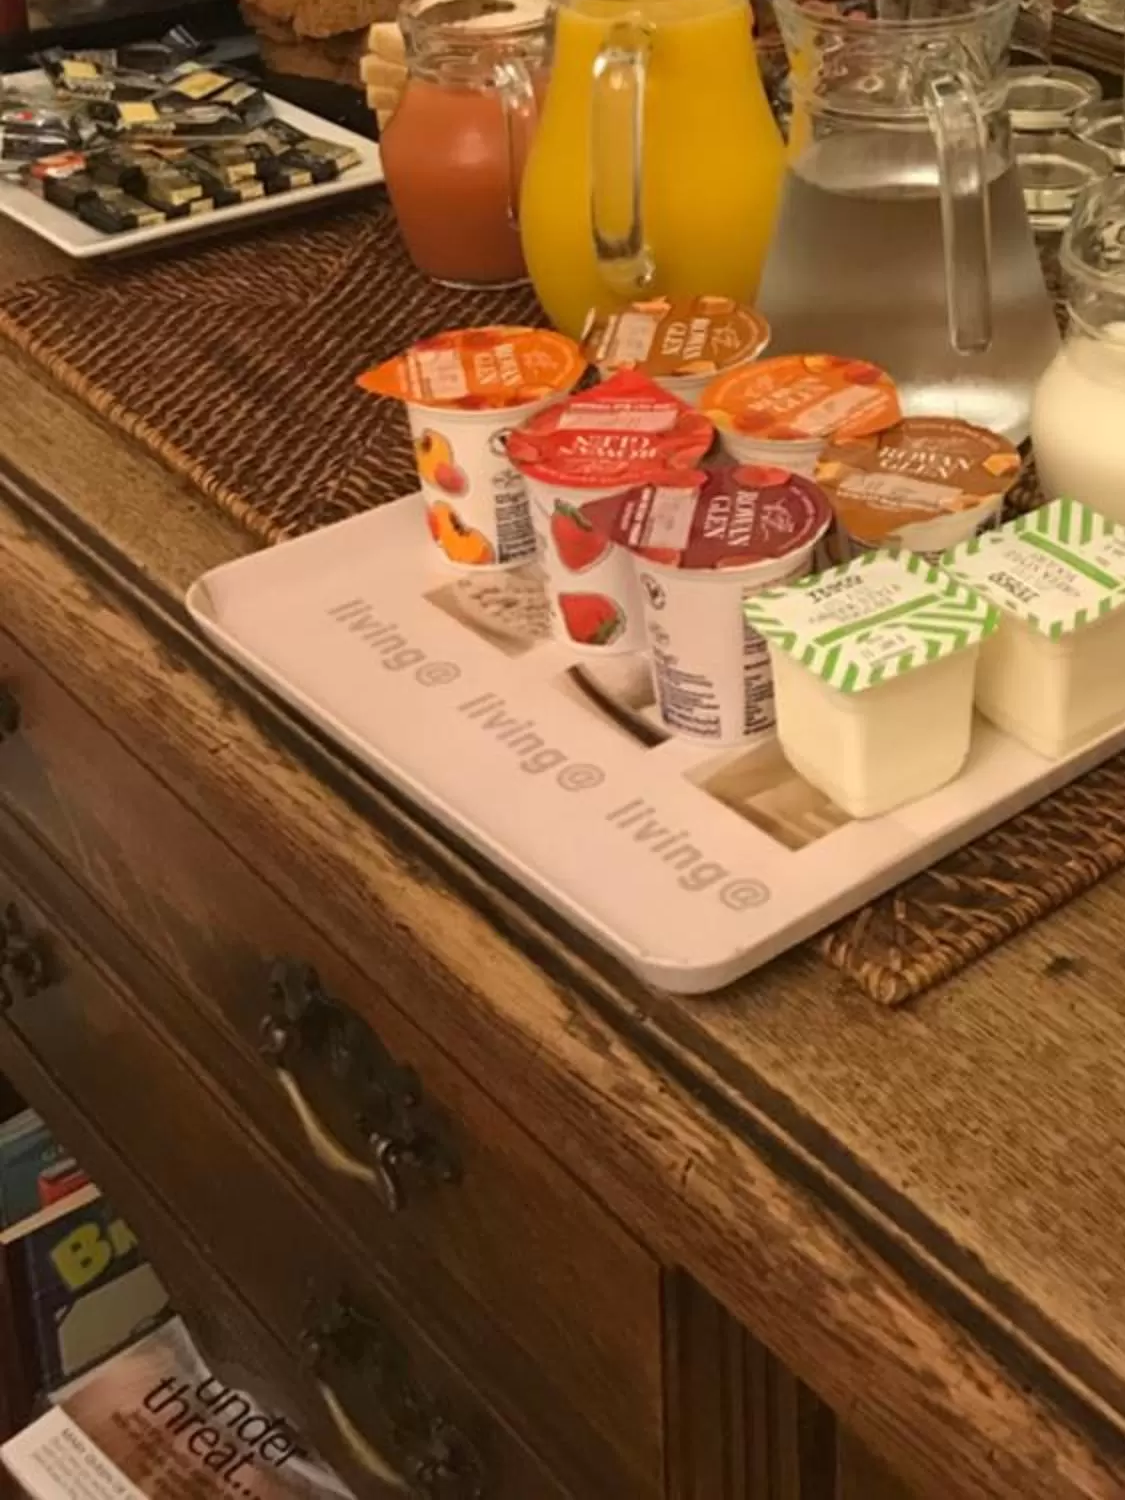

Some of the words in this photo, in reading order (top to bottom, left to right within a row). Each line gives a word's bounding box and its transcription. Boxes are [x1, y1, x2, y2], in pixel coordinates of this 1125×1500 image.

[704, 495, 731, 539] GLEN
[728, 490, 760, 546] ROWAN
[328, 598, 462, 688] living@
[457, 692, 606, 792] living@
[605, 798, 771, 912] living@
[196, 1377, 302, 1468] under
